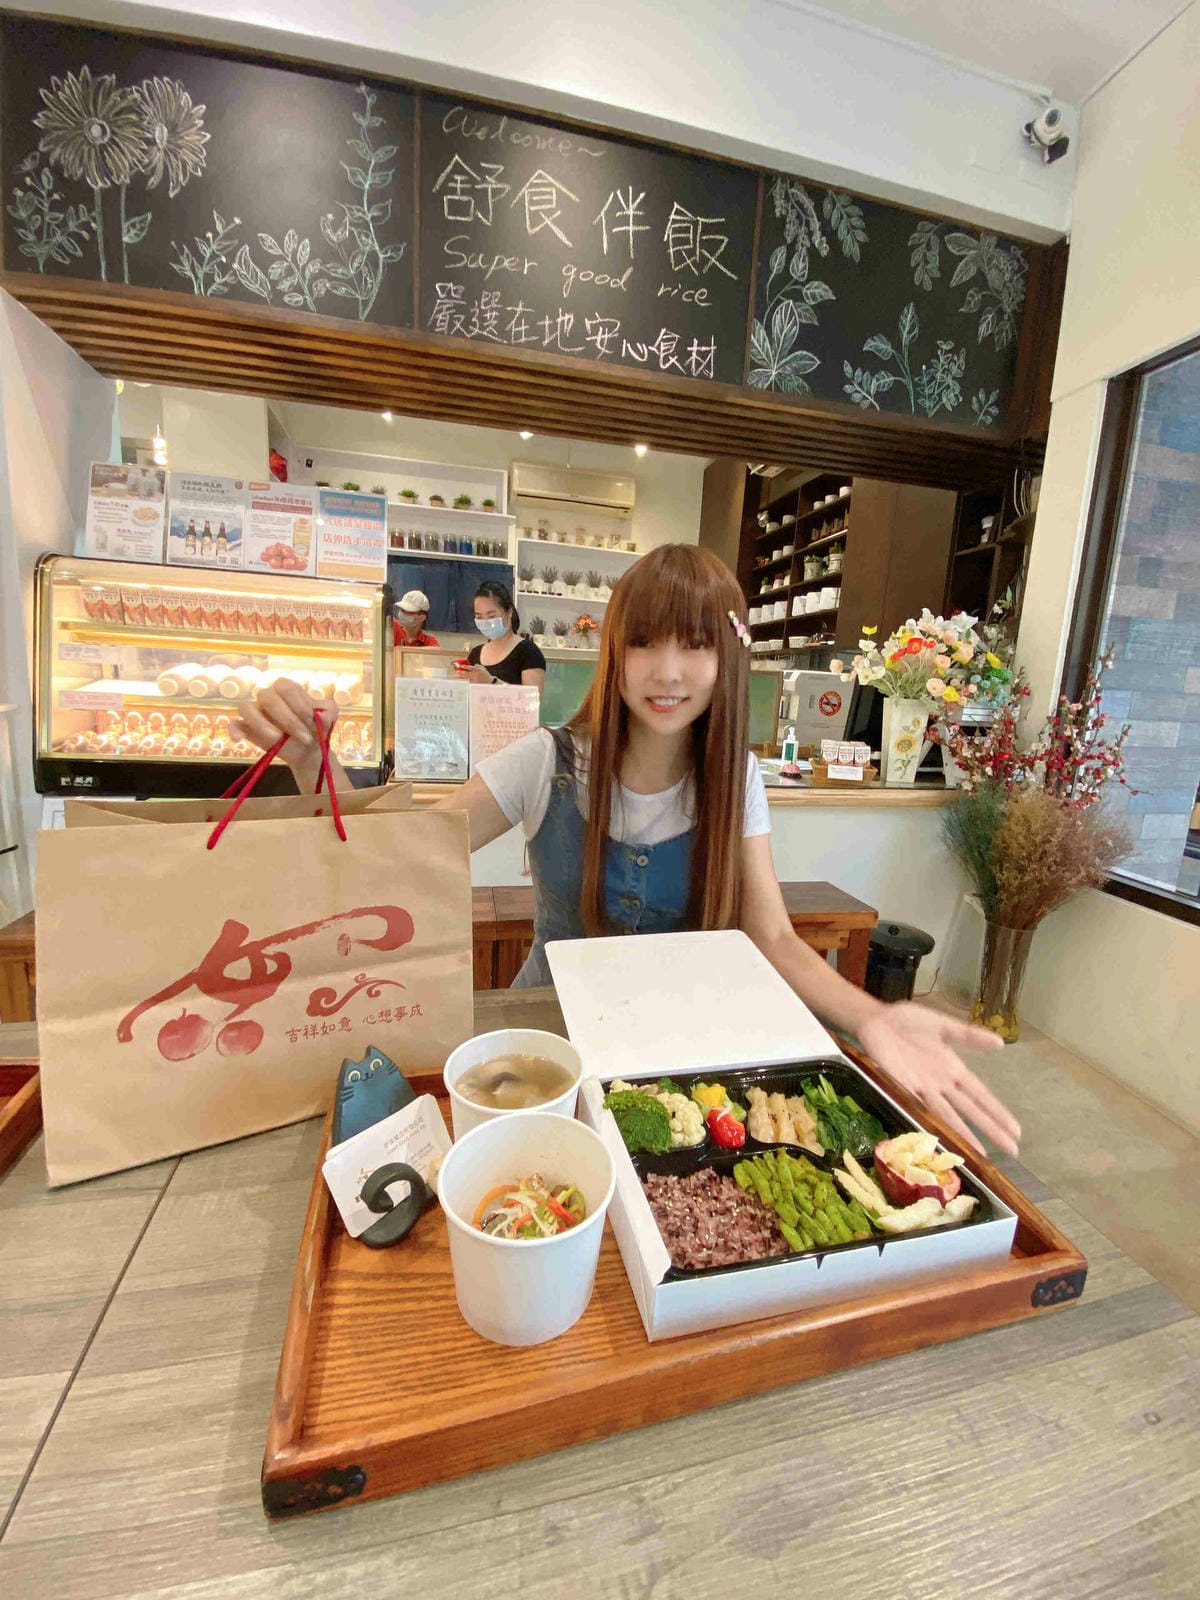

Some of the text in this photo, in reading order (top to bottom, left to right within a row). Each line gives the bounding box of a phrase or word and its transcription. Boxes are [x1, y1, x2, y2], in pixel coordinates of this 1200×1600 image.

[432, 153, 738, 280] 舒食伴飯
[443, 235, 713, 307] Super good rice
[427, 281, 717, 379] 嚴選在地安心食材
[285, 1003, 424, 1043] 吉祥如意 心想事成
